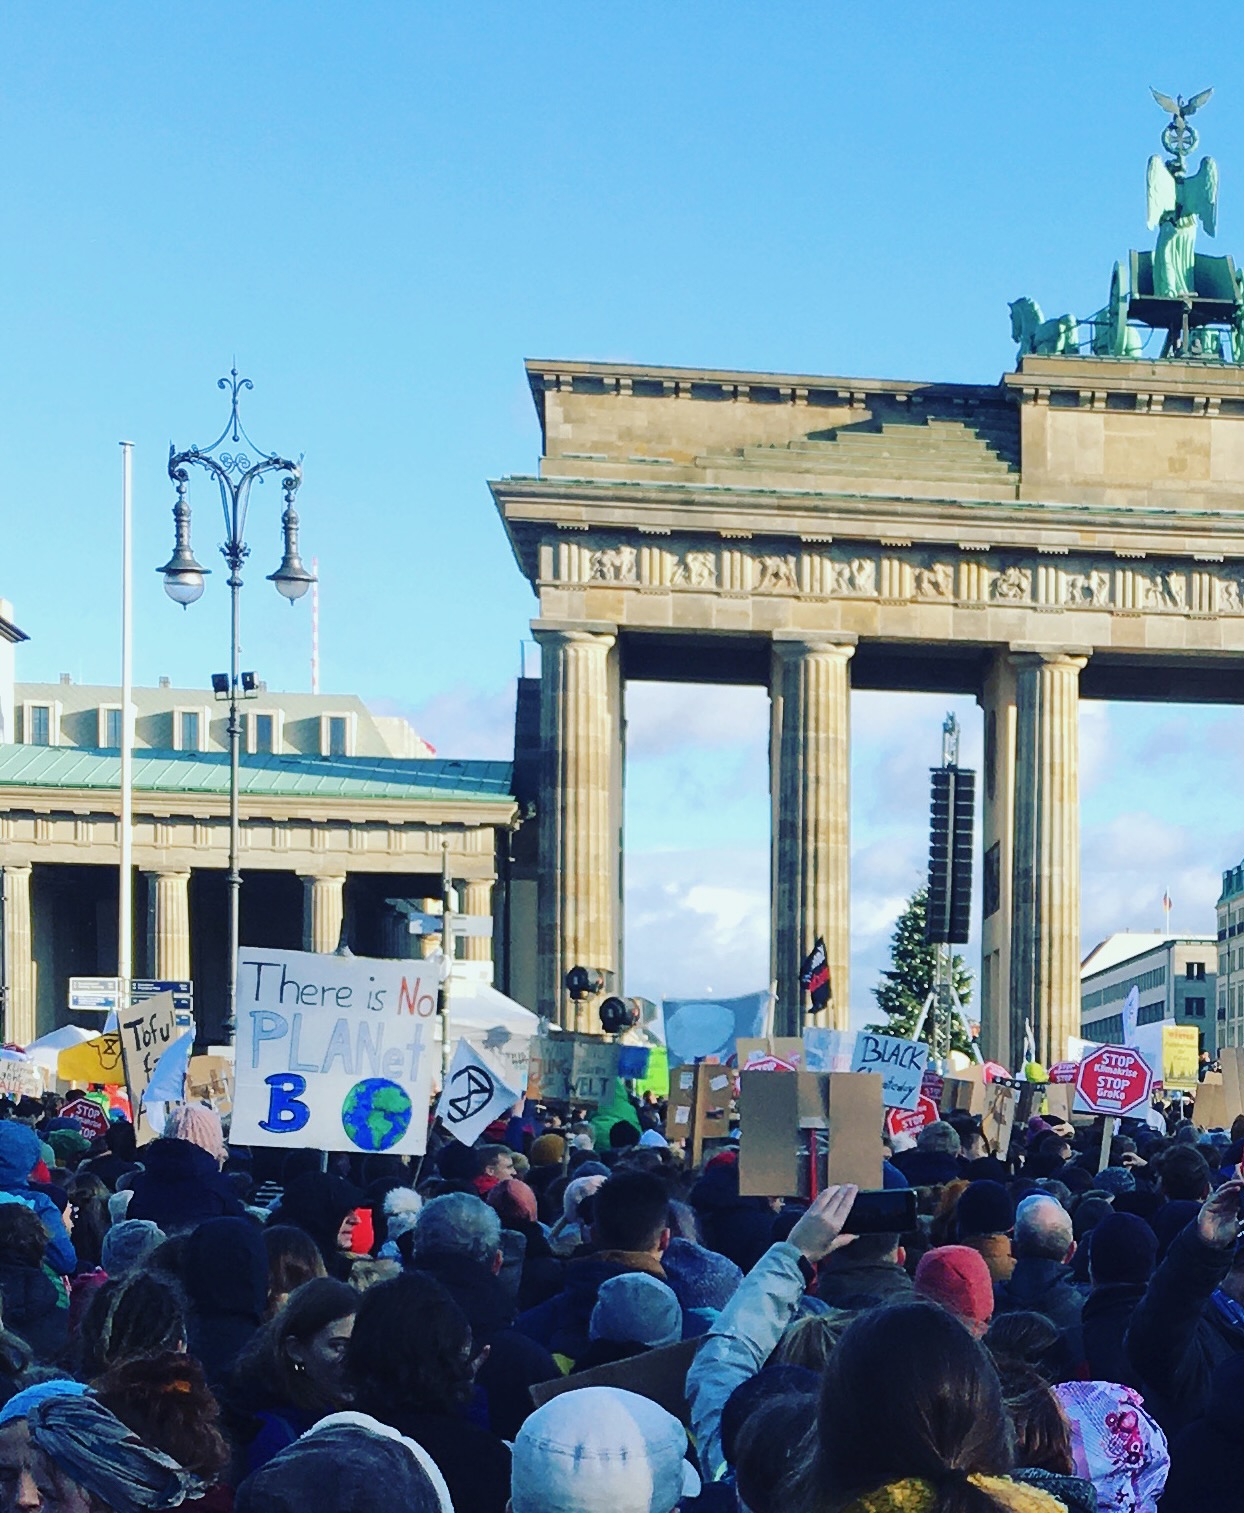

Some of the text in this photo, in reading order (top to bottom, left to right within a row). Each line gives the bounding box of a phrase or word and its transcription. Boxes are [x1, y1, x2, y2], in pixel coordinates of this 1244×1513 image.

[243, 961, 435, 1017] There is No
[861, 1036, 925, 1070] BLACK
[1101, 1053, 1135, 1068] STOP
[1093, 1064, 1138, 1079] Klimakrise
[1096, 1076, 1130, 1090] STOP
[1096, 1088, 1126, 1101] GroKo
[258, 1073, 311, 1134] B
[76, 1104, 100, 1119] STOP
[79, 1126, 97, 1139] TOP
